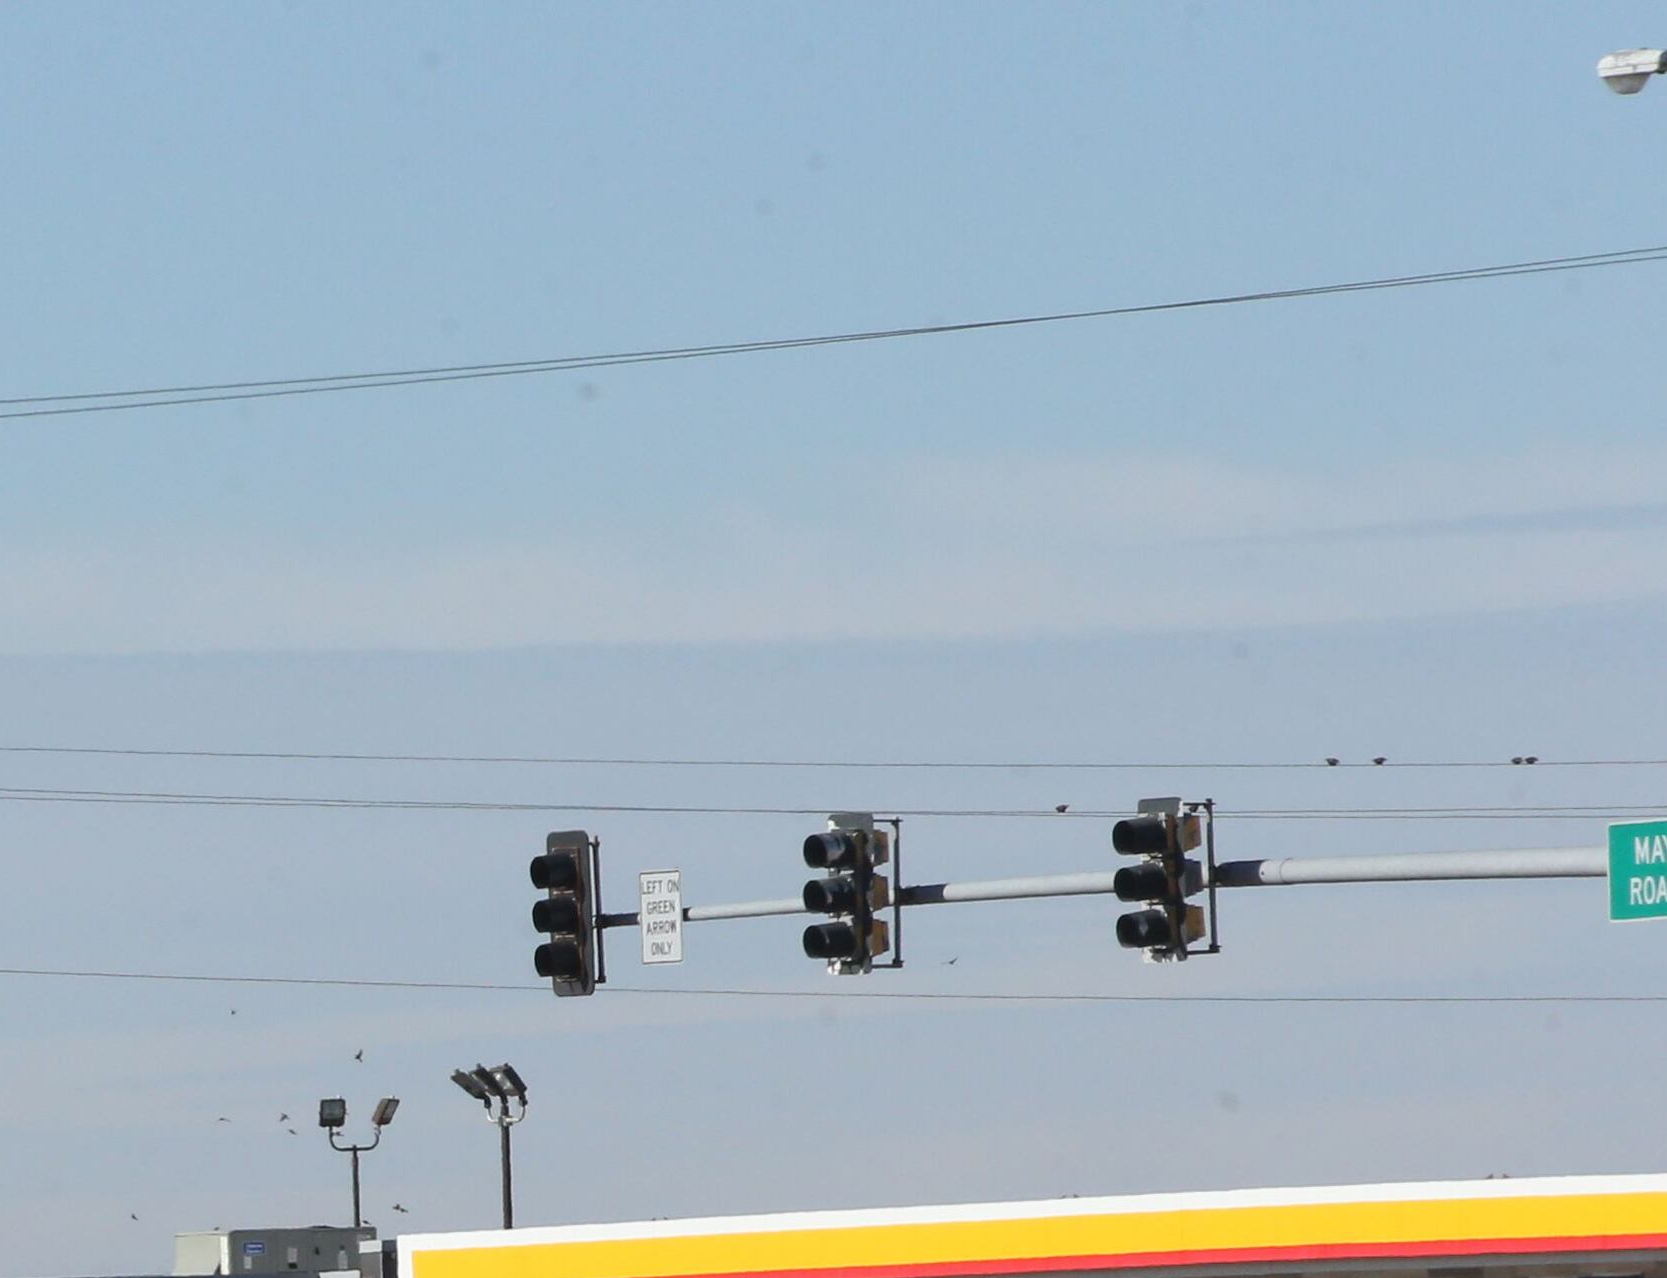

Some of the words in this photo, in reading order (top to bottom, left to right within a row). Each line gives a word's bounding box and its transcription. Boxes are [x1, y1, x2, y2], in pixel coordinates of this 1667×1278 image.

[642, 880, 663, 894] LEFT
[667, 879, 680, 893] ON
[1629, 875, 1667, 905] ROA
[647, 901, 676, 915] GREEN
[647, 920, 677, 934] ARROW
[651, 941, 673, 956] ONLY
